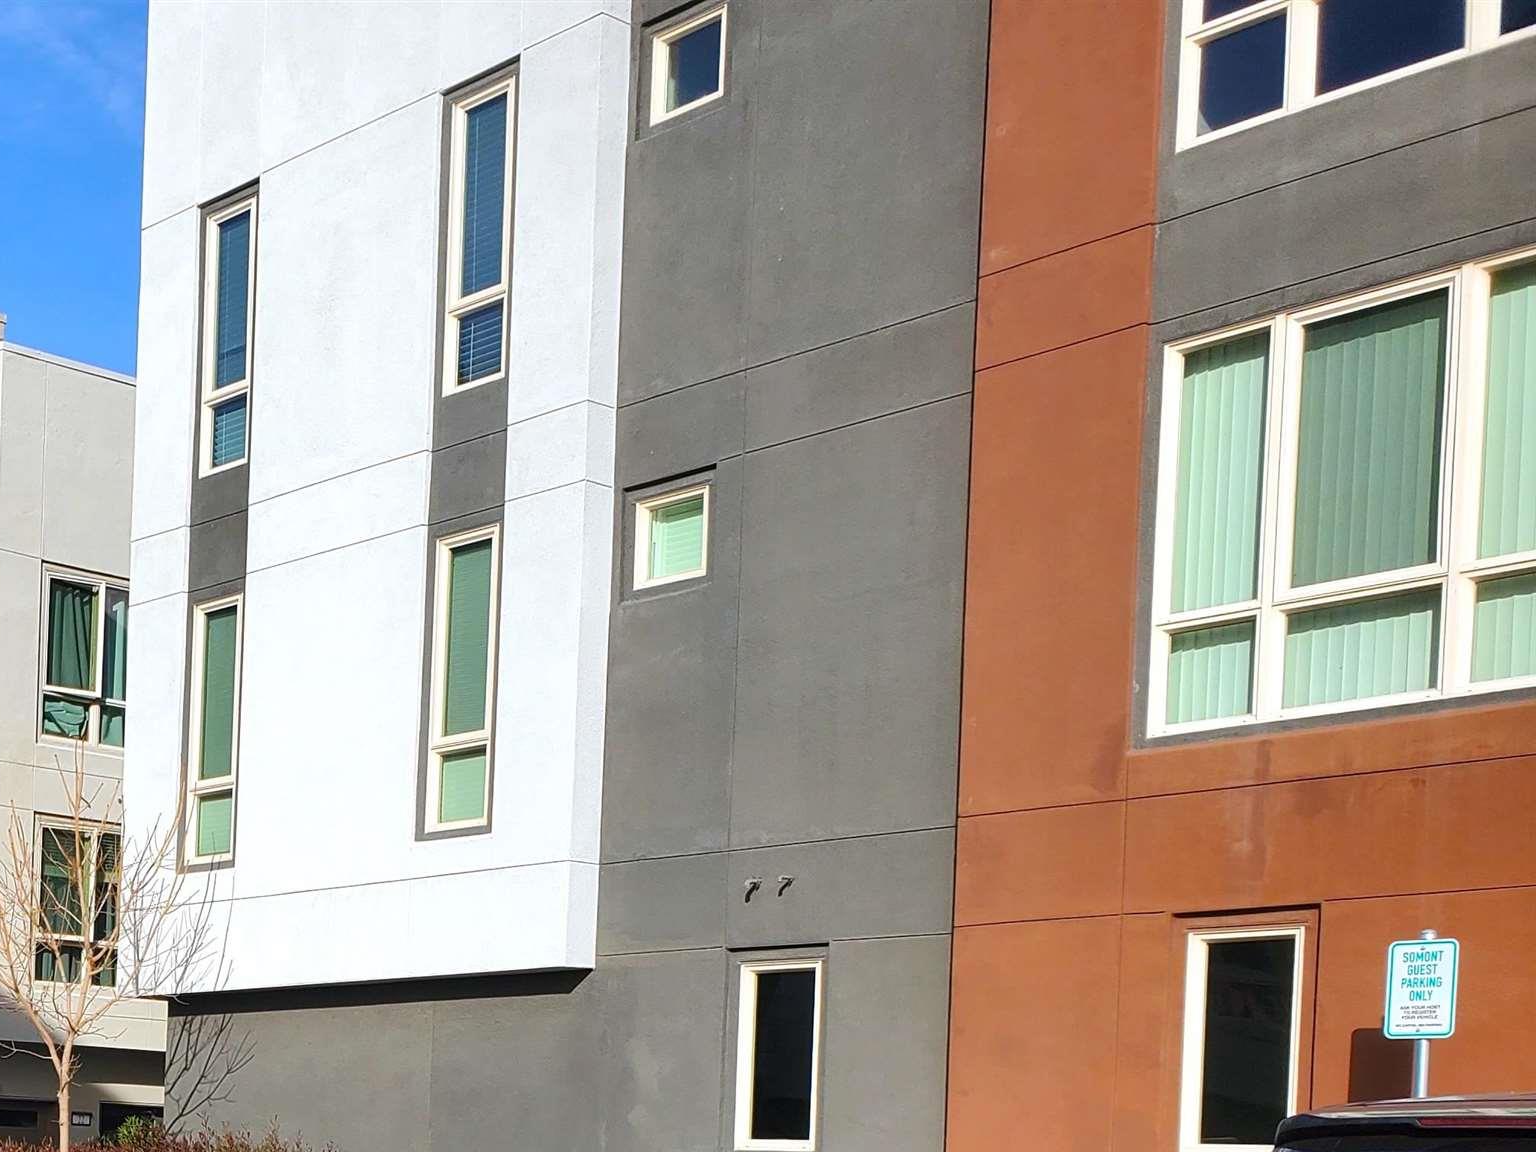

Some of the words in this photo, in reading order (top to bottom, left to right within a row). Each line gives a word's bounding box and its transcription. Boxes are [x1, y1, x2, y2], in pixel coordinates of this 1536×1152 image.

[1402, 950, 1444, 963] SOMONT
[1407, 964, 1438, 976] GUEST
[1401, 976, 1443, 989] PARKING
[1409, 989, 1433, 1001] ONLY
